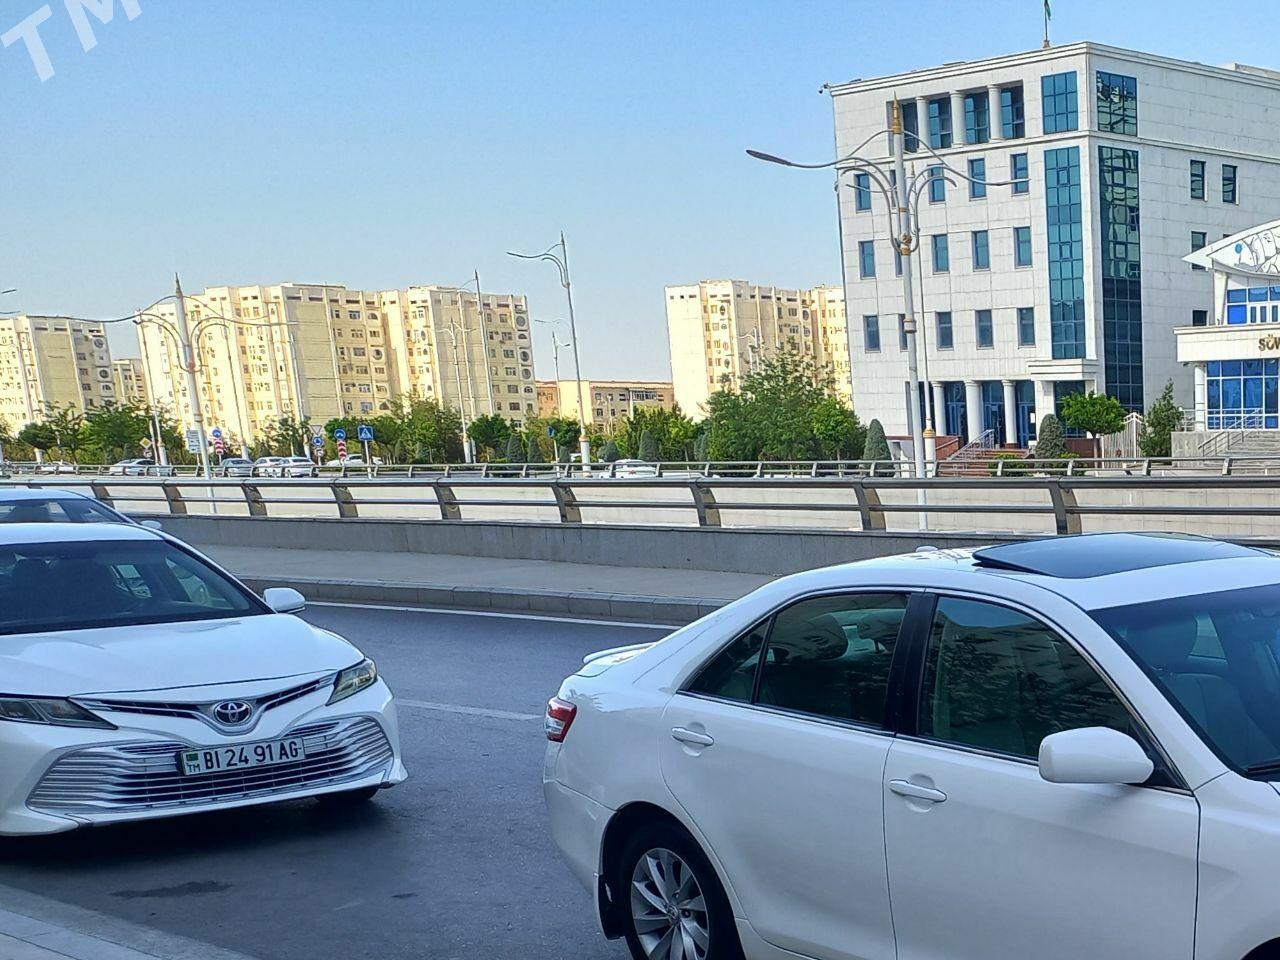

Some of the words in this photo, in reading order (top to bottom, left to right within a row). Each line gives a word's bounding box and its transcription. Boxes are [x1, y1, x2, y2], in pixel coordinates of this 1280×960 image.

[203, 751, 220, 769] BI
[224, 747, 249, 767] 24
[253, 745, 273, 762] 91
[279, 741, 299, 760] AG
